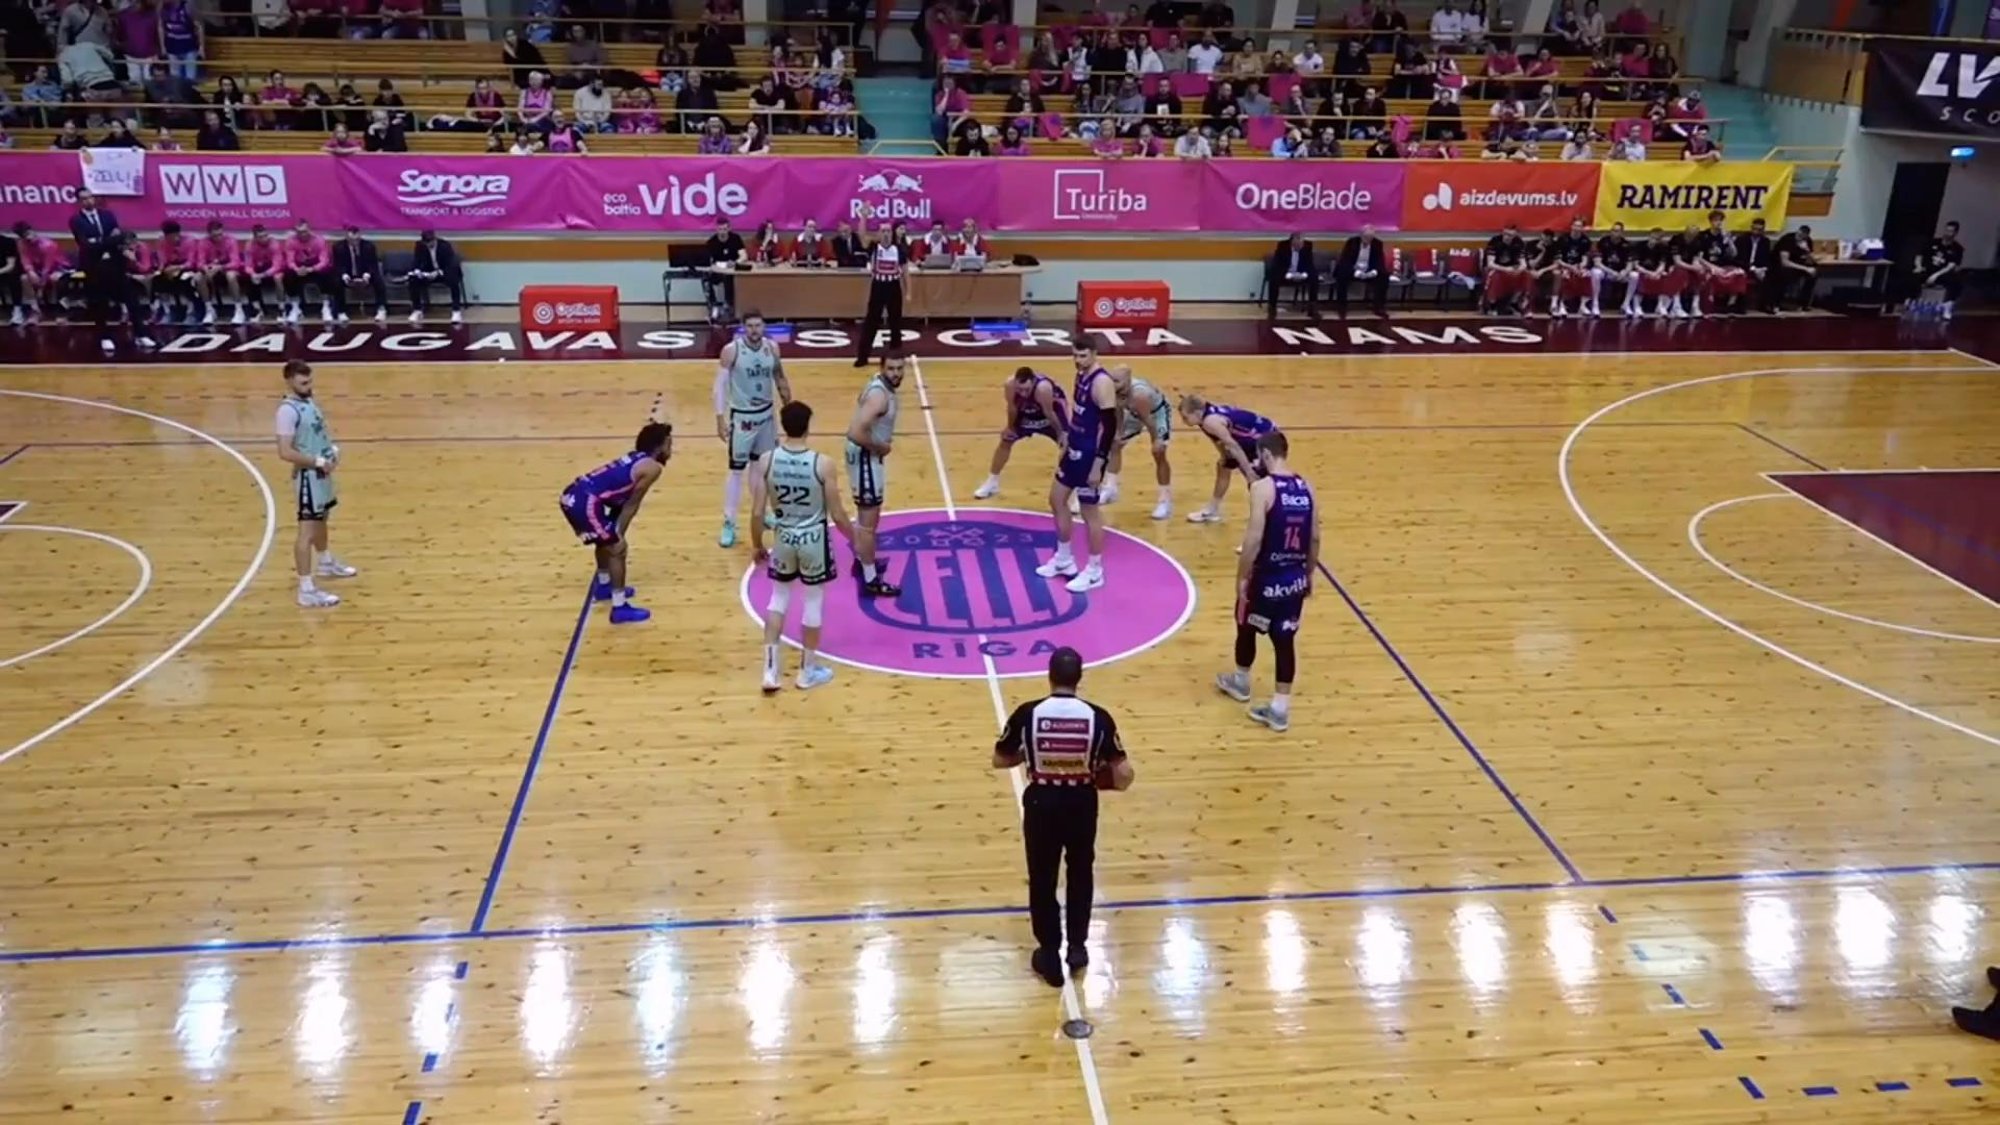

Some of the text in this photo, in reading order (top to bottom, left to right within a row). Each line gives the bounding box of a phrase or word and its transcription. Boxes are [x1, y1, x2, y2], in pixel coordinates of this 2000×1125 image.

[164, 172, 277, 196] WWD
[397, 169, 510, 193] Sonora
[603, 193, 627, 203] eco
[893, 198, 931, 218] Bull
[1065, 188, 1147, 212] Turība
[1235, 182, 1372, 211] OneBlade
[1459, 189, 1577, 206] aizdevums.lv
[1617, 184, 1769, 209] RAMIRENT
[166, 209, 291, 218] WOODEN WALL DESIGN
[400, 207, 450, 216] TRANSPORT
[461, 207, 506, 216] LOGISTICS
[159, 330, 696, 353] DAUGAVAS
[1271, 325, 1543, 345] NAMS
[774, 484, 811, 506] 22
